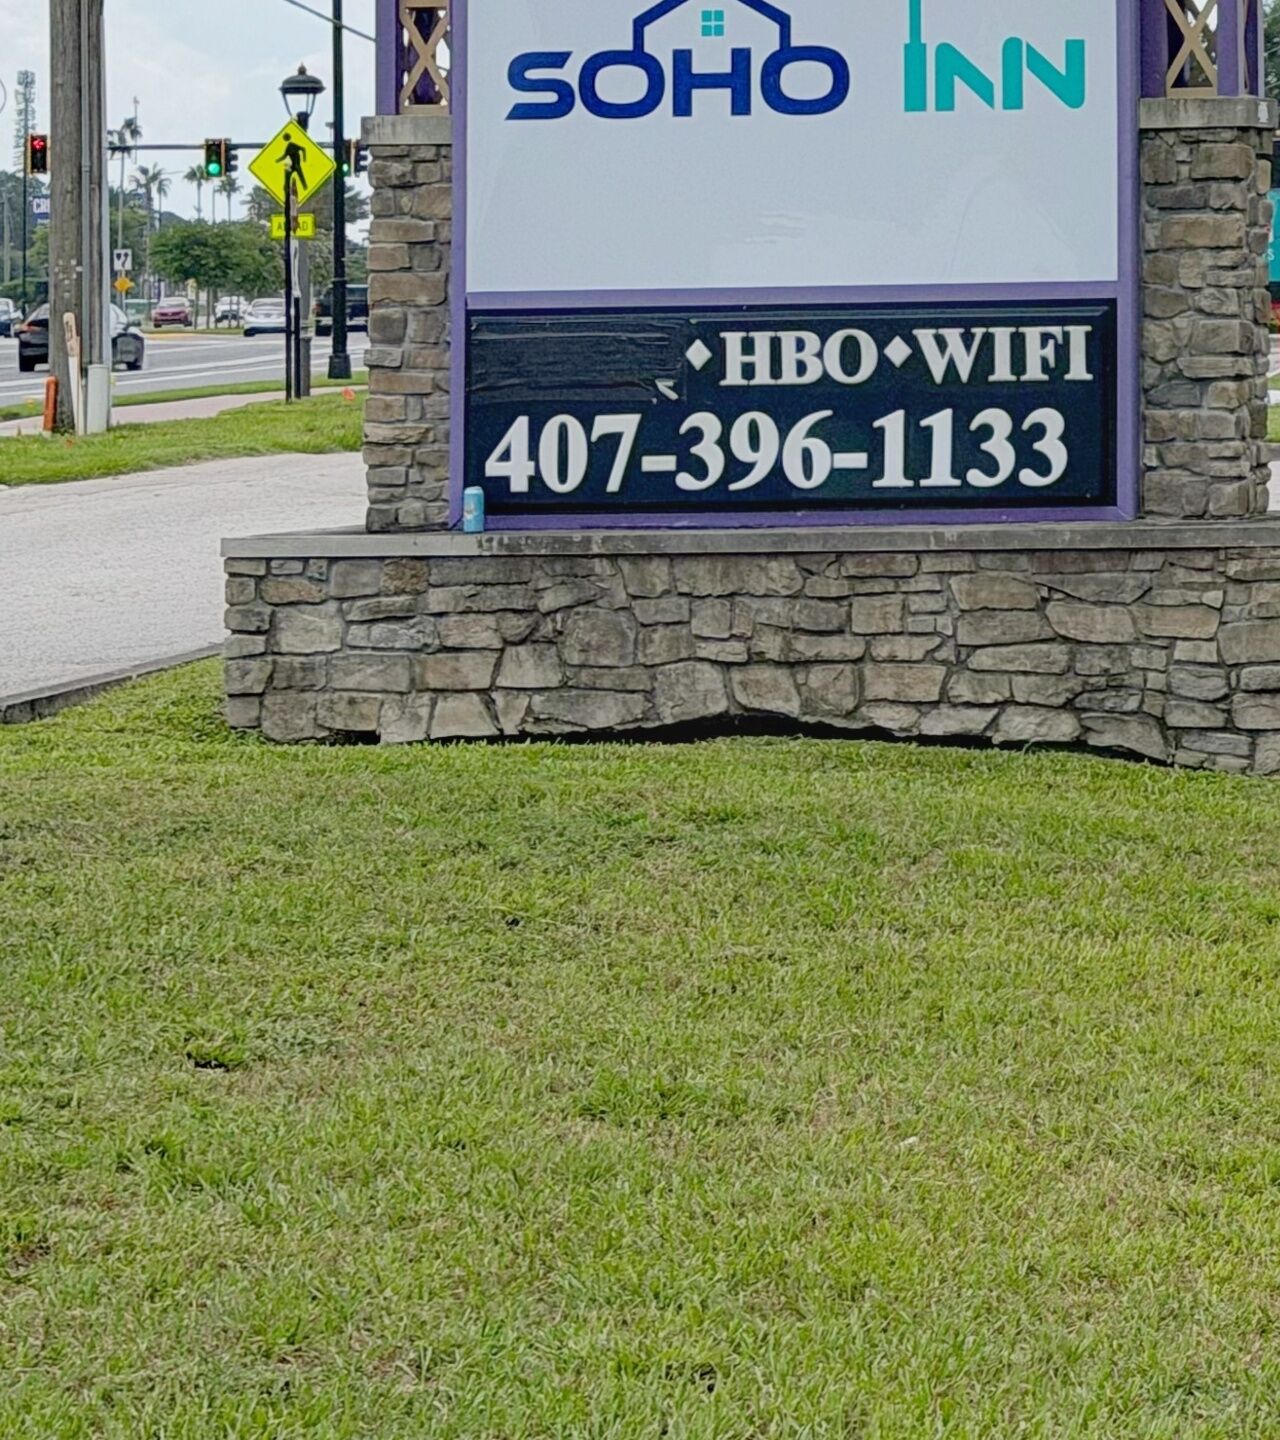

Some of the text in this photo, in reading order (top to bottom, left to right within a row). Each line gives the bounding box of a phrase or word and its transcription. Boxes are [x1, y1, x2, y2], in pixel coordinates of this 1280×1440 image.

[504, 36, 1086, 121] SOHO INN
[719, 325, 1093, 387] HBO WIFI
[484, 407, 1069, 494] 407-396-1133
